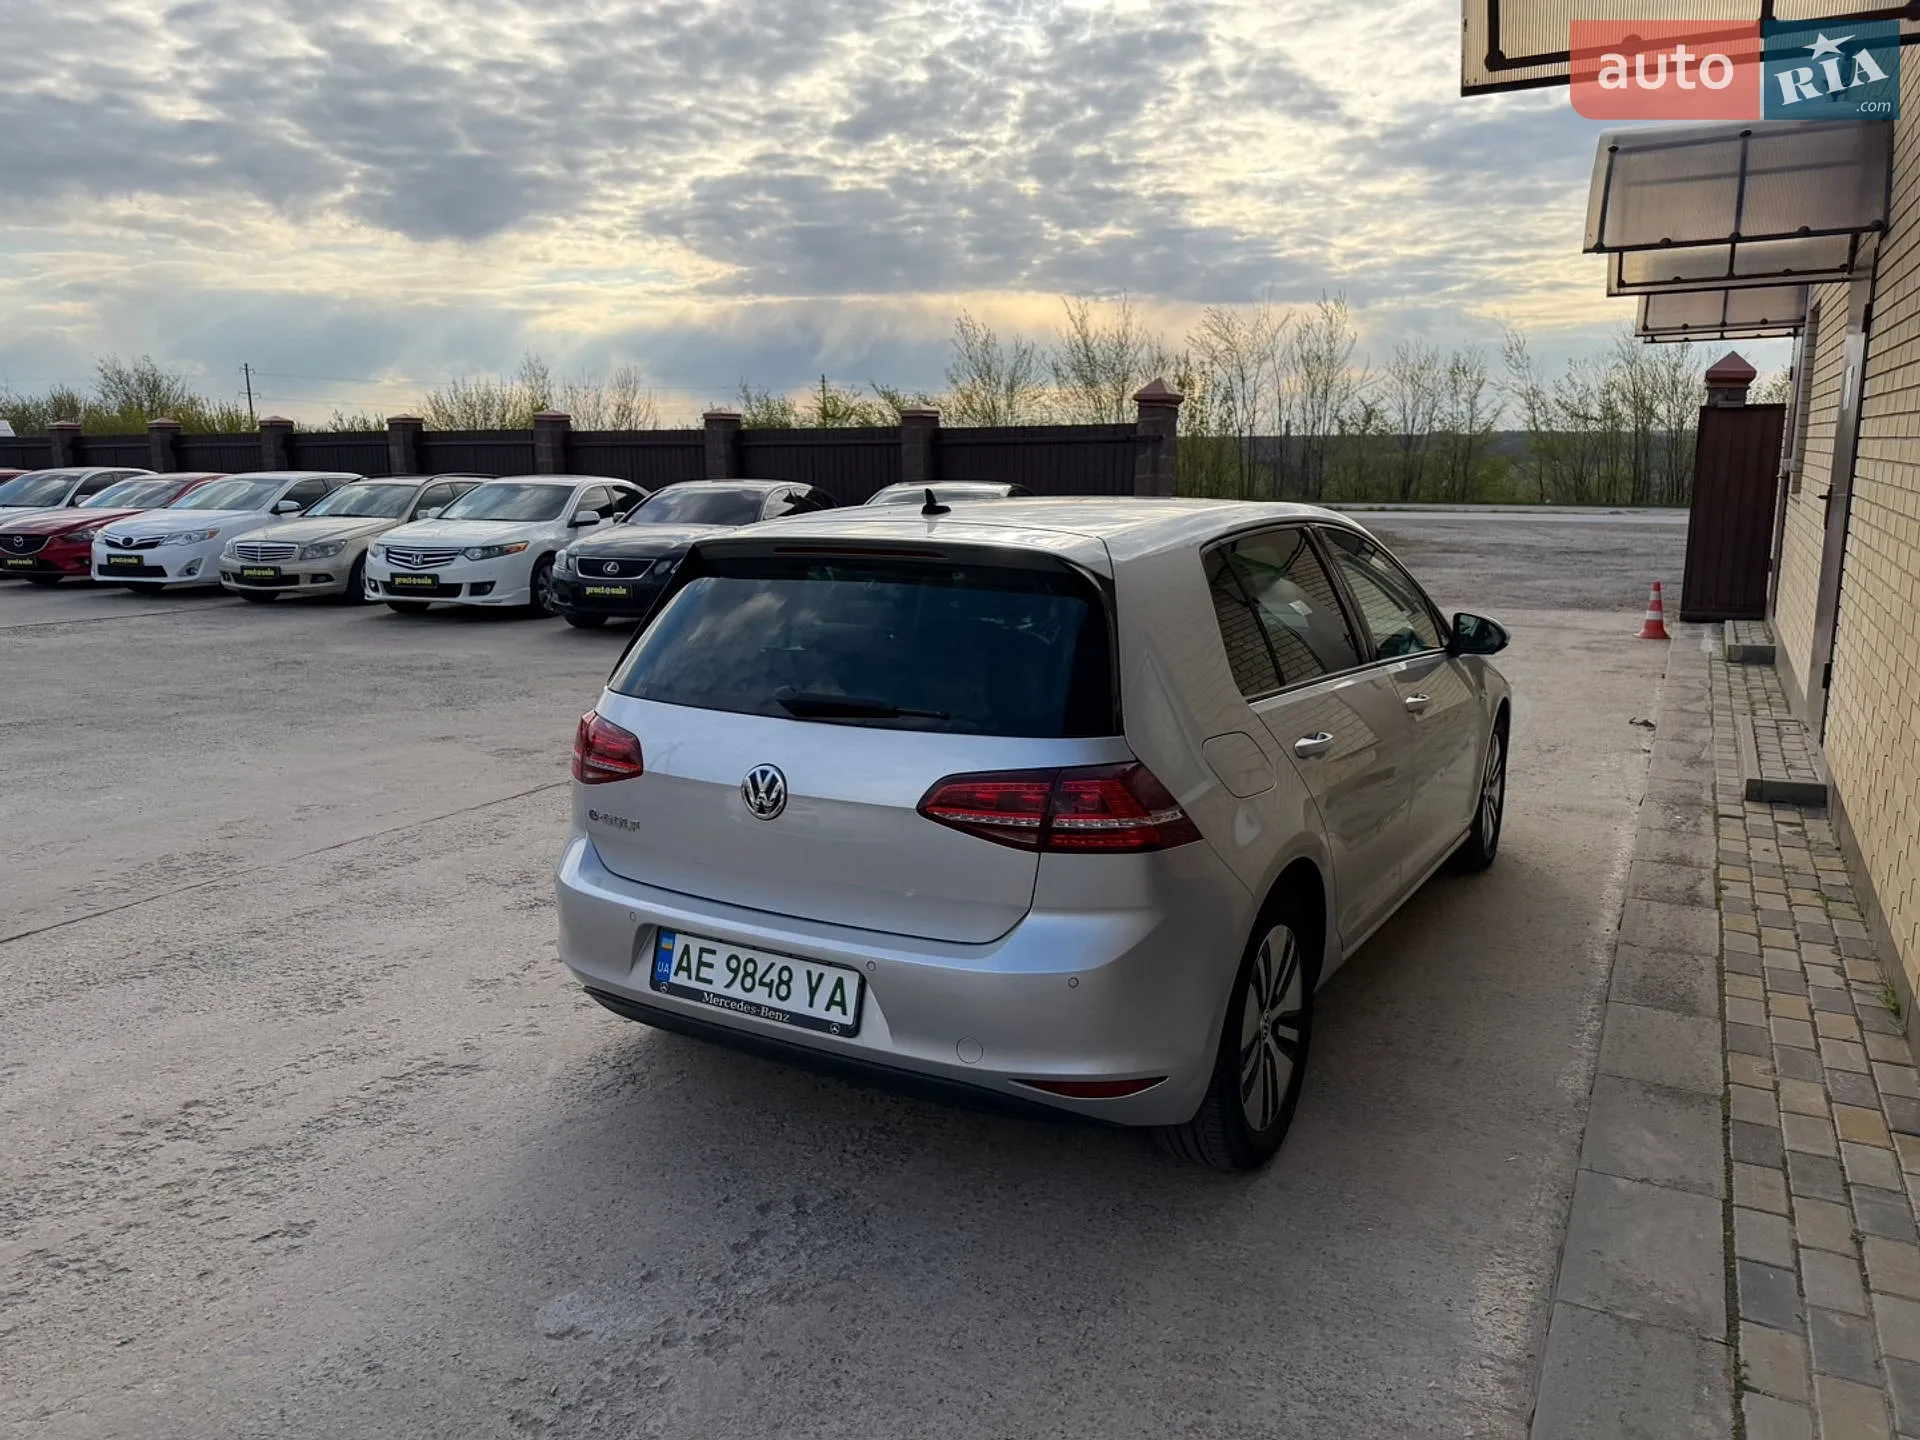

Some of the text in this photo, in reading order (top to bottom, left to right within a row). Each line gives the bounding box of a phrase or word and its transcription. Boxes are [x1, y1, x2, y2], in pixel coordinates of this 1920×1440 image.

[657, 961, 670, 974] UA
[673, 943, 848, 1016] AE 9848 YA
[702, 991, 790, 1023] Mercedes-Benz
